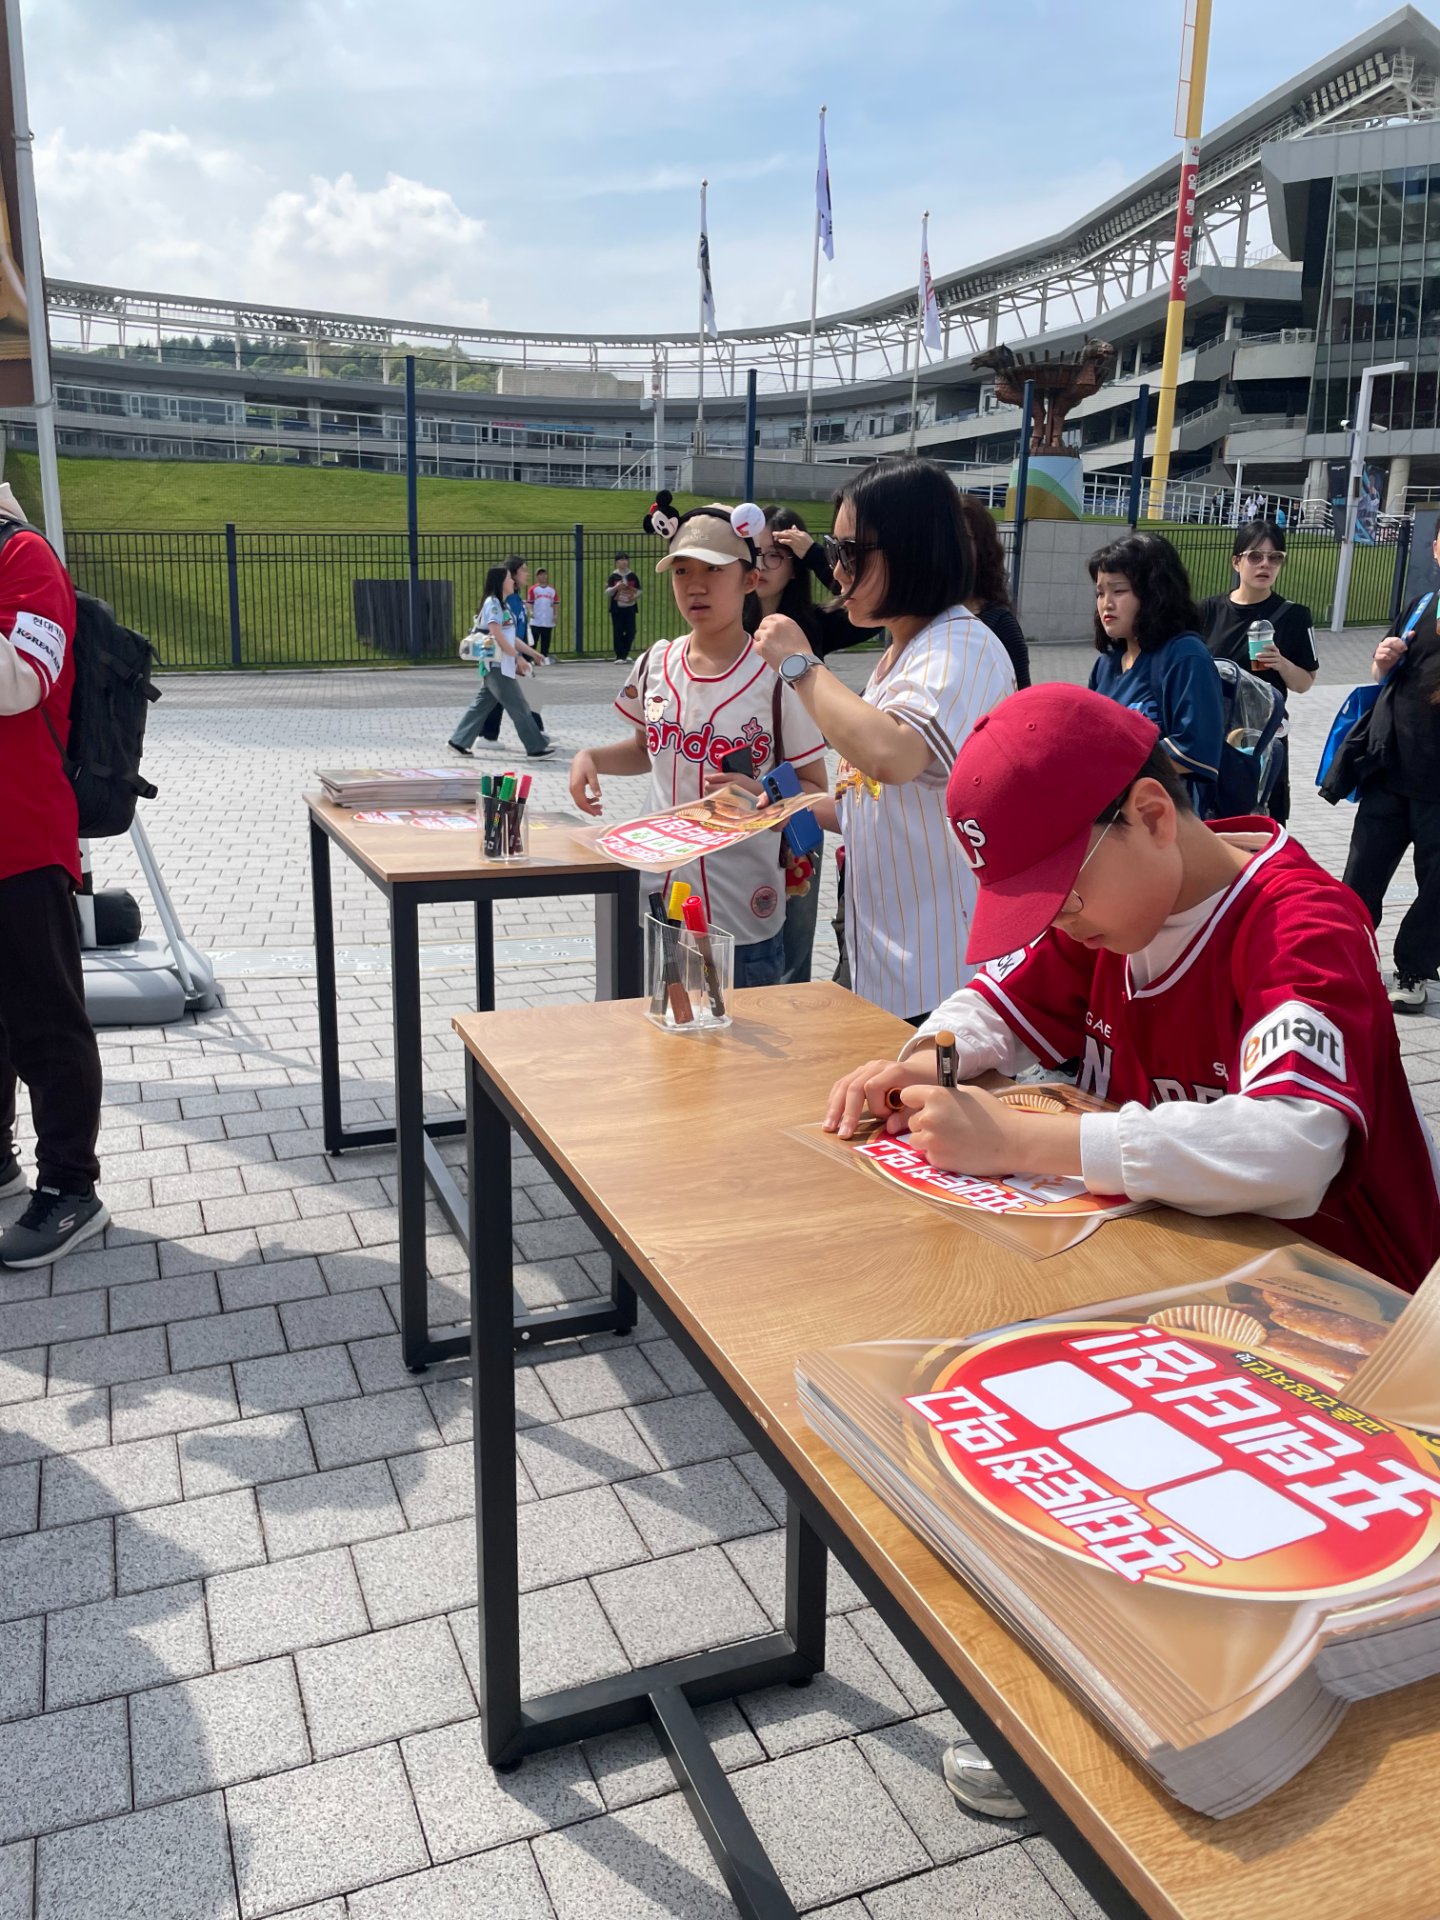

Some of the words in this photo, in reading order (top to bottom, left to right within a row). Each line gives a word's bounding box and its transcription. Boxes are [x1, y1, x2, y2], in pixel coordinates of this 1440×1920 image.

[17, 627, 54, 657] KOREAN
[1243, 1016, 1342, 1073] emart
[853, 1140, 921, 1169] 먹고
[904, 1386, 1018, 1453] 먹고
[1330, 1406, 1390, 1436] 교촌
[976, 1447, 1222, 1583] 포테토칩
